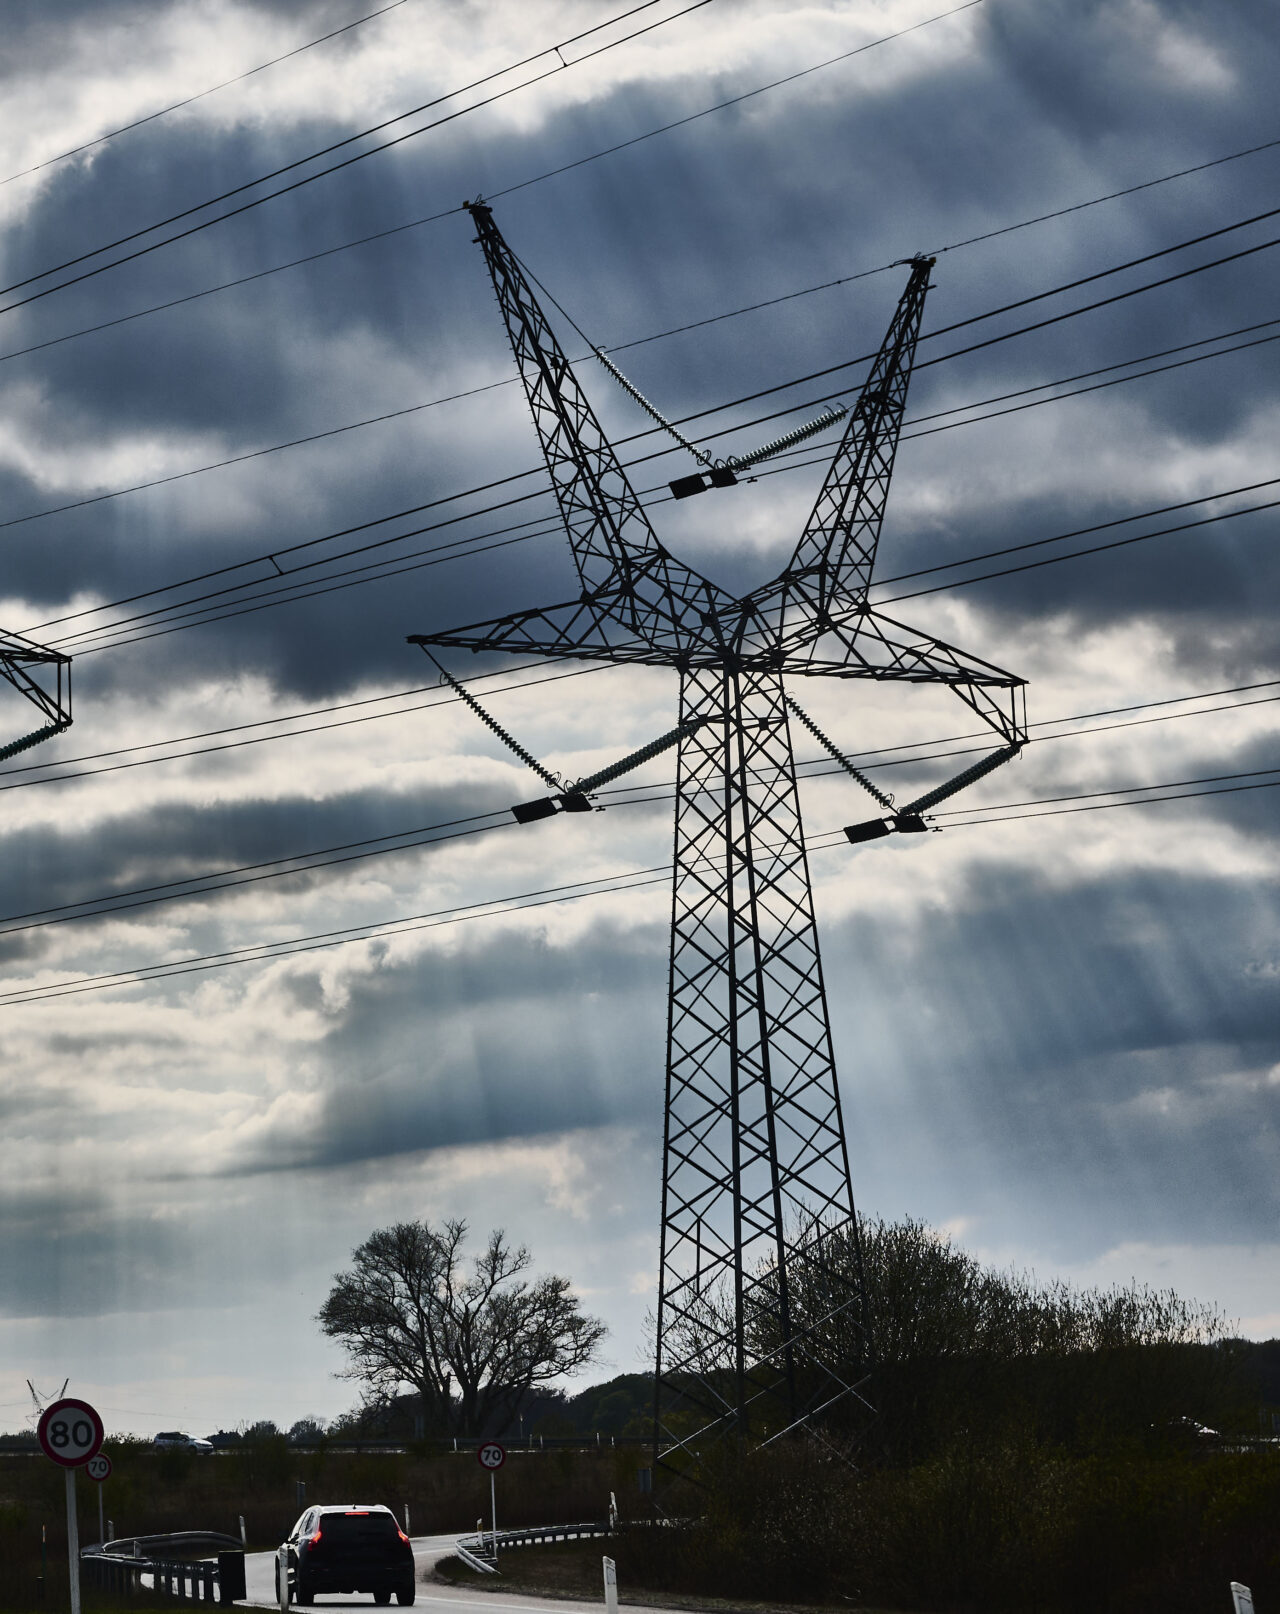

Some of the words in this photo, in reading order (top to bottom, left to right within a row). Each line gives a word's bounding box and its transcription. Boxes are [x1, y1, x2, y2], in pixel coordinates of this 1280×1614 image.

[50, 1421, 92, 1447] 80
[483, 1450, 501, 1461] 70
[90, 1461, 107, 1472] 70
